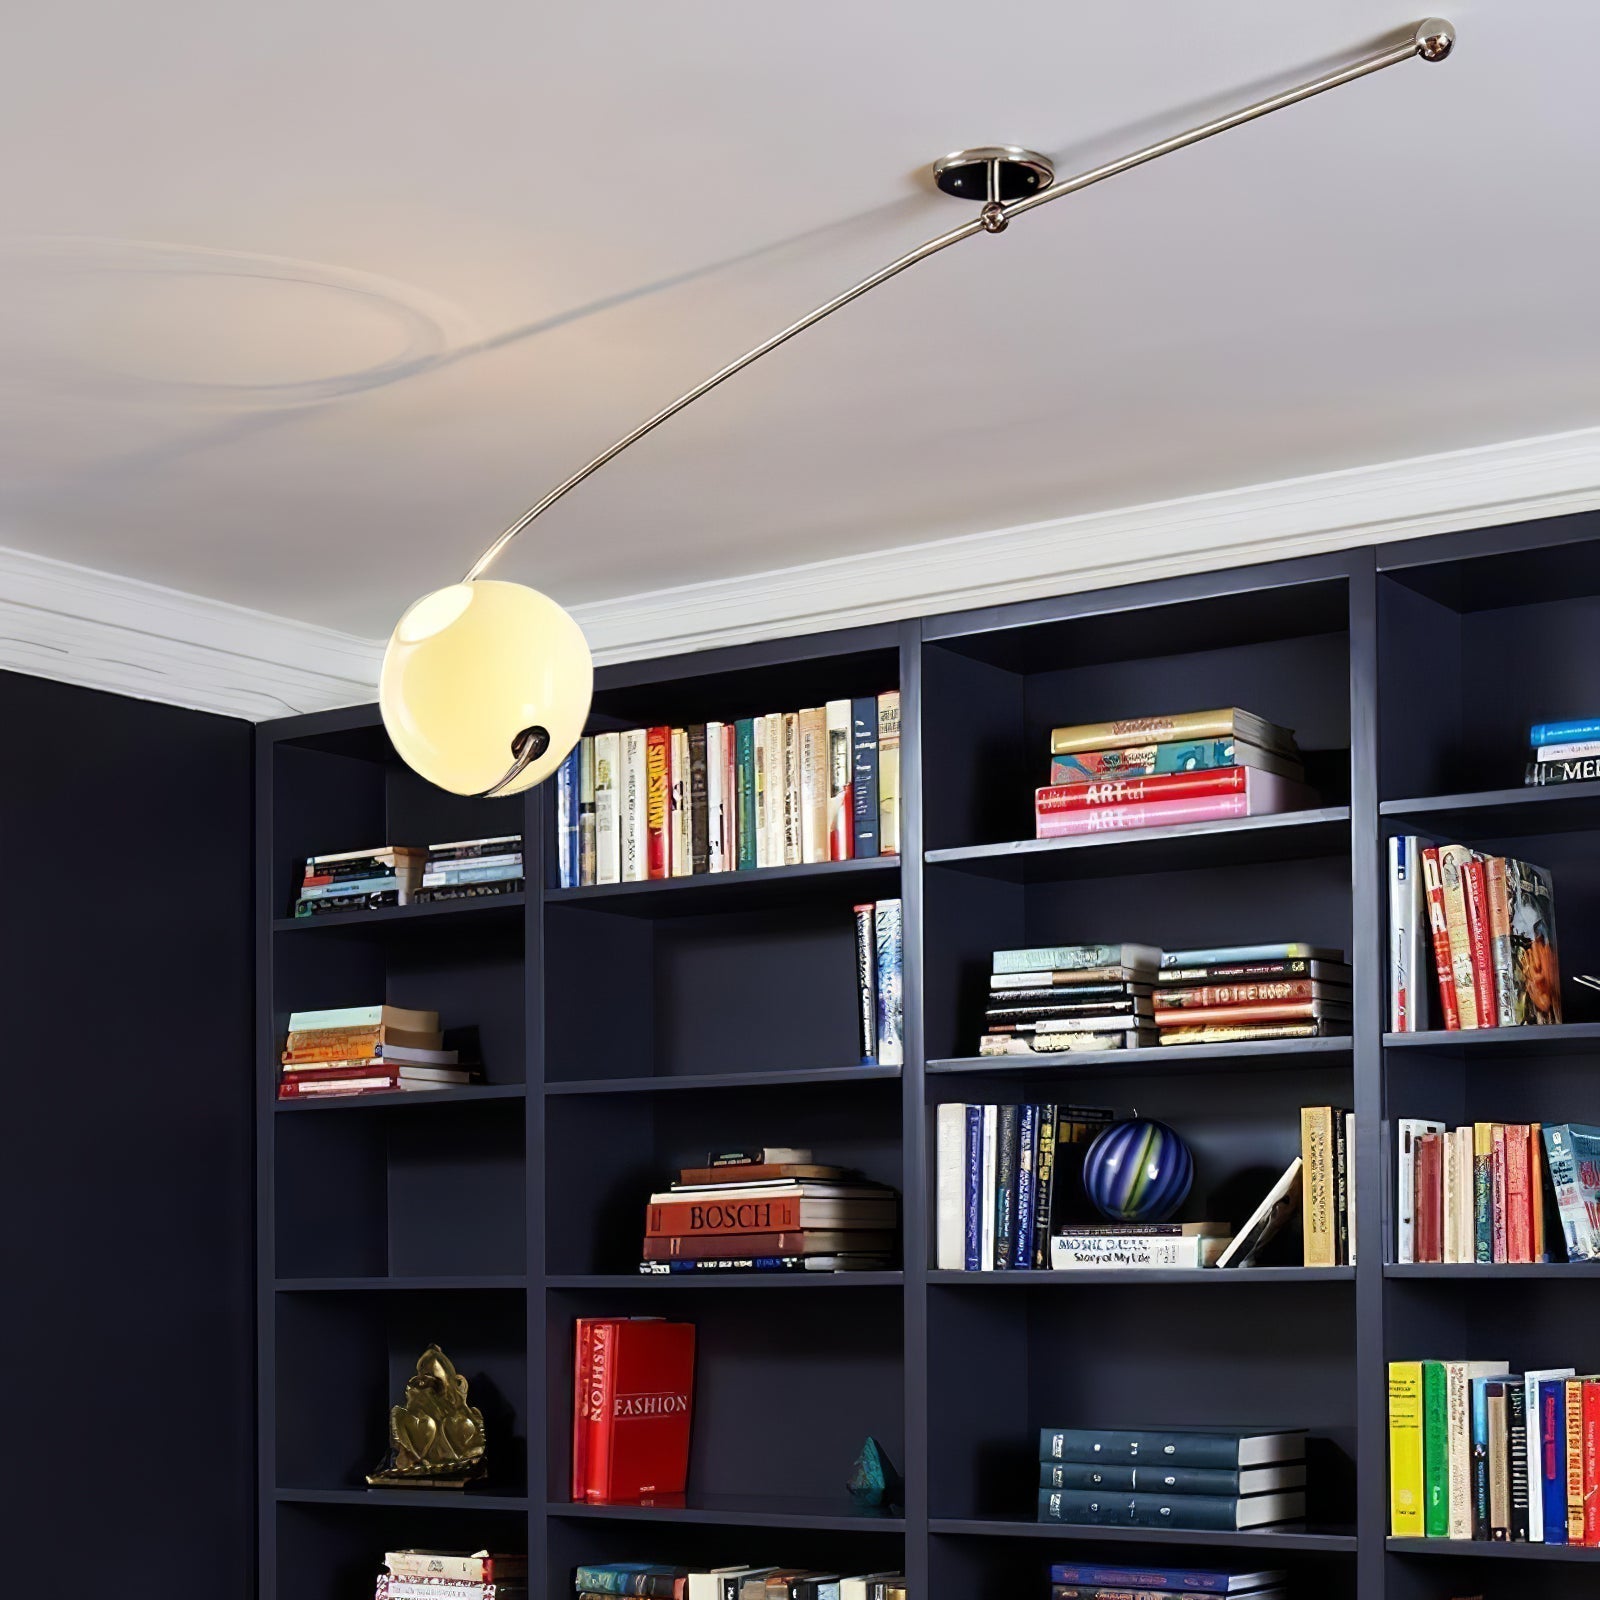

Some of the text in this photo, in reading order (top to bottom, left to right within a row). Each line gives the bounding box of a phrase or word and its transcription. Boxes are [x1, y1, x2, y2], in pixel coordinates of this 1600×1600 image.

[690, 1203, 771, 1230] BOSCH
[590, 1324, 606, 1422] FASHION
[614, 1395, 688, 1416] FASHION
